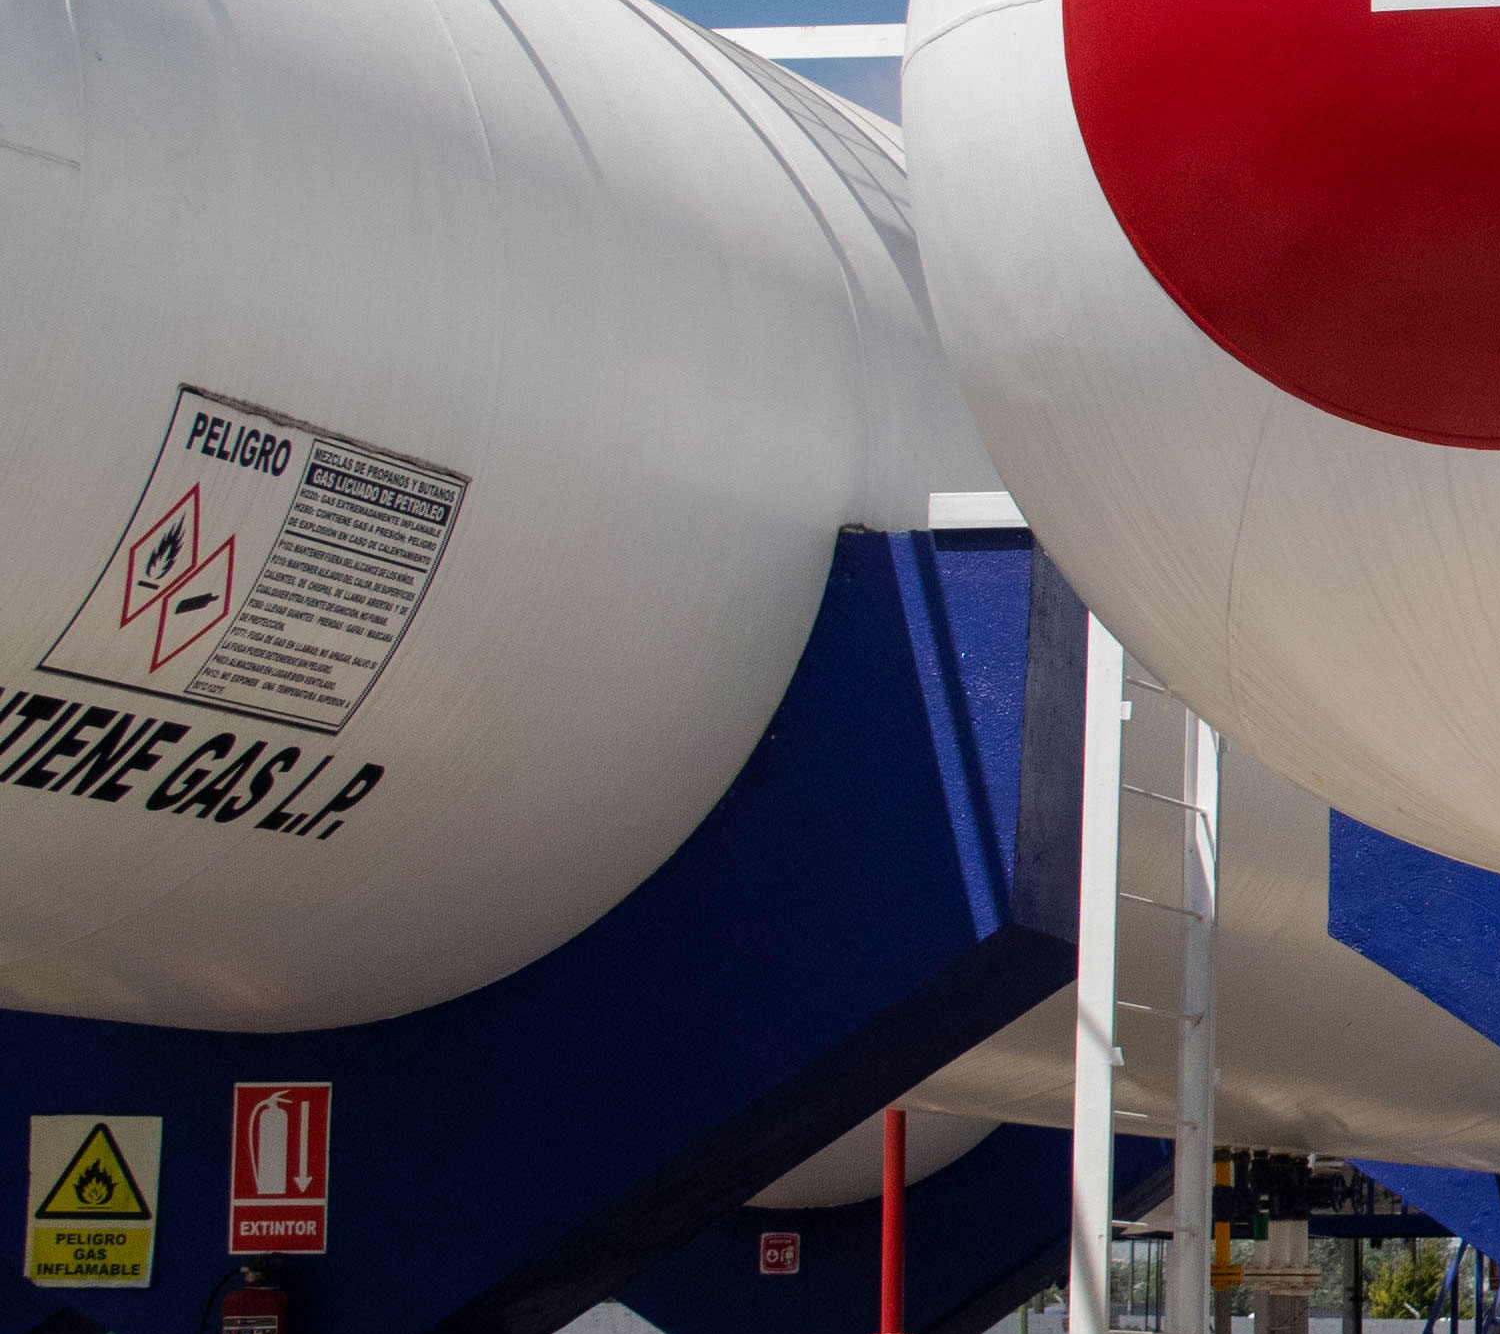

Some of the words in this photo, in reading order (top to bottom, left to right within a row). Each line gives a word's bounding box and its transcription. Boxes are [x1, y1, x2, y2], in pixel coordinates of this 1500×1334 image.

[186, 411, 292, 477] PELIGRO
[314, 447, 353, 470] MEZCLAS
[354, 460, 365, 475] DE
[367, 464, 410, 490] PROPANOS
[410, 476, 418, 490] Y
[418, 478, 456, 504] BUTANOS
[313, 469, 336, 487] GAS
[335, 474, 380, 502] LICUADO
[379, 489, 395, 507] DE
[393, 493, 445, 521] PETROLEO
[320, 494, 335, 505] GAS
[0, 689, 192, 803] TIENE
[145, 733, 301, 823] GAS
[253, 755, 386, 840] L.P.
[240, 1220, 317, 1236] EXTINTOR
[55, 1233, 127, 1246] PELIGRO
[73, 1248, 107, 1261] GAS
[37, 1264, 141, 1276] INFLAMABLE
